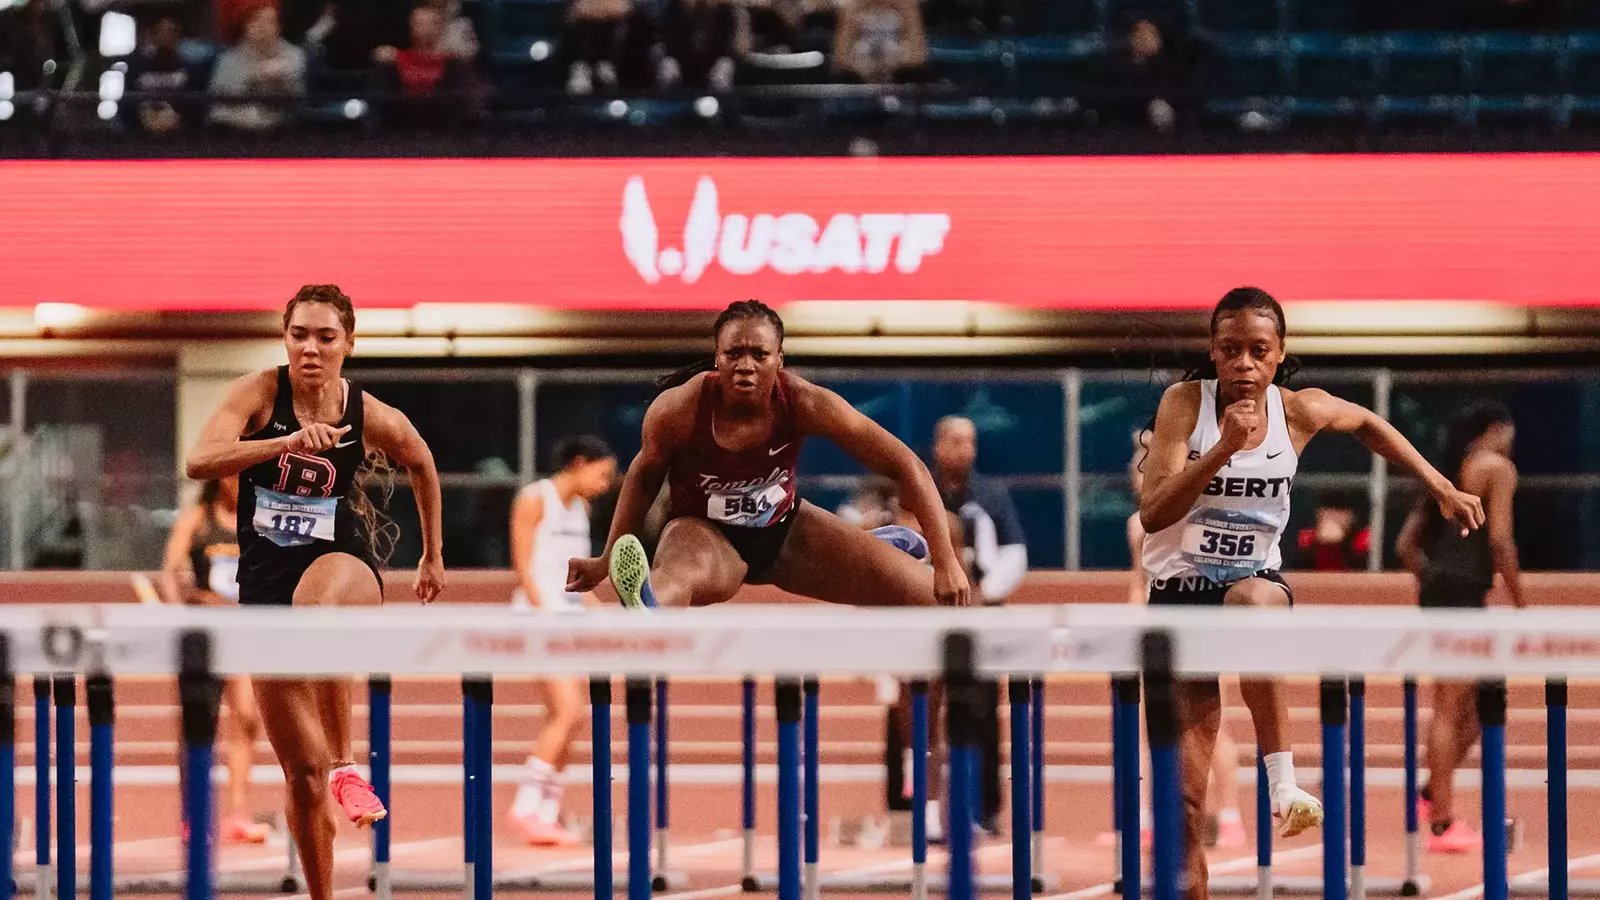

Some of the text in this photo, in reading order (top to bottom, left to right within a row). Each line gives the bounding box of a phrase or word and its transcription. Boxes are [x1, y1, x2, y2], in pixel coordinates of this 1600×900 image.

[718, 213, 951, 274] USATF
[273, 451, 337, 498] B
[1202, 476, 1292, 498] BERTY
[271, 514, 317, 538] 187
[1199, 530, 1256, 557] 356
